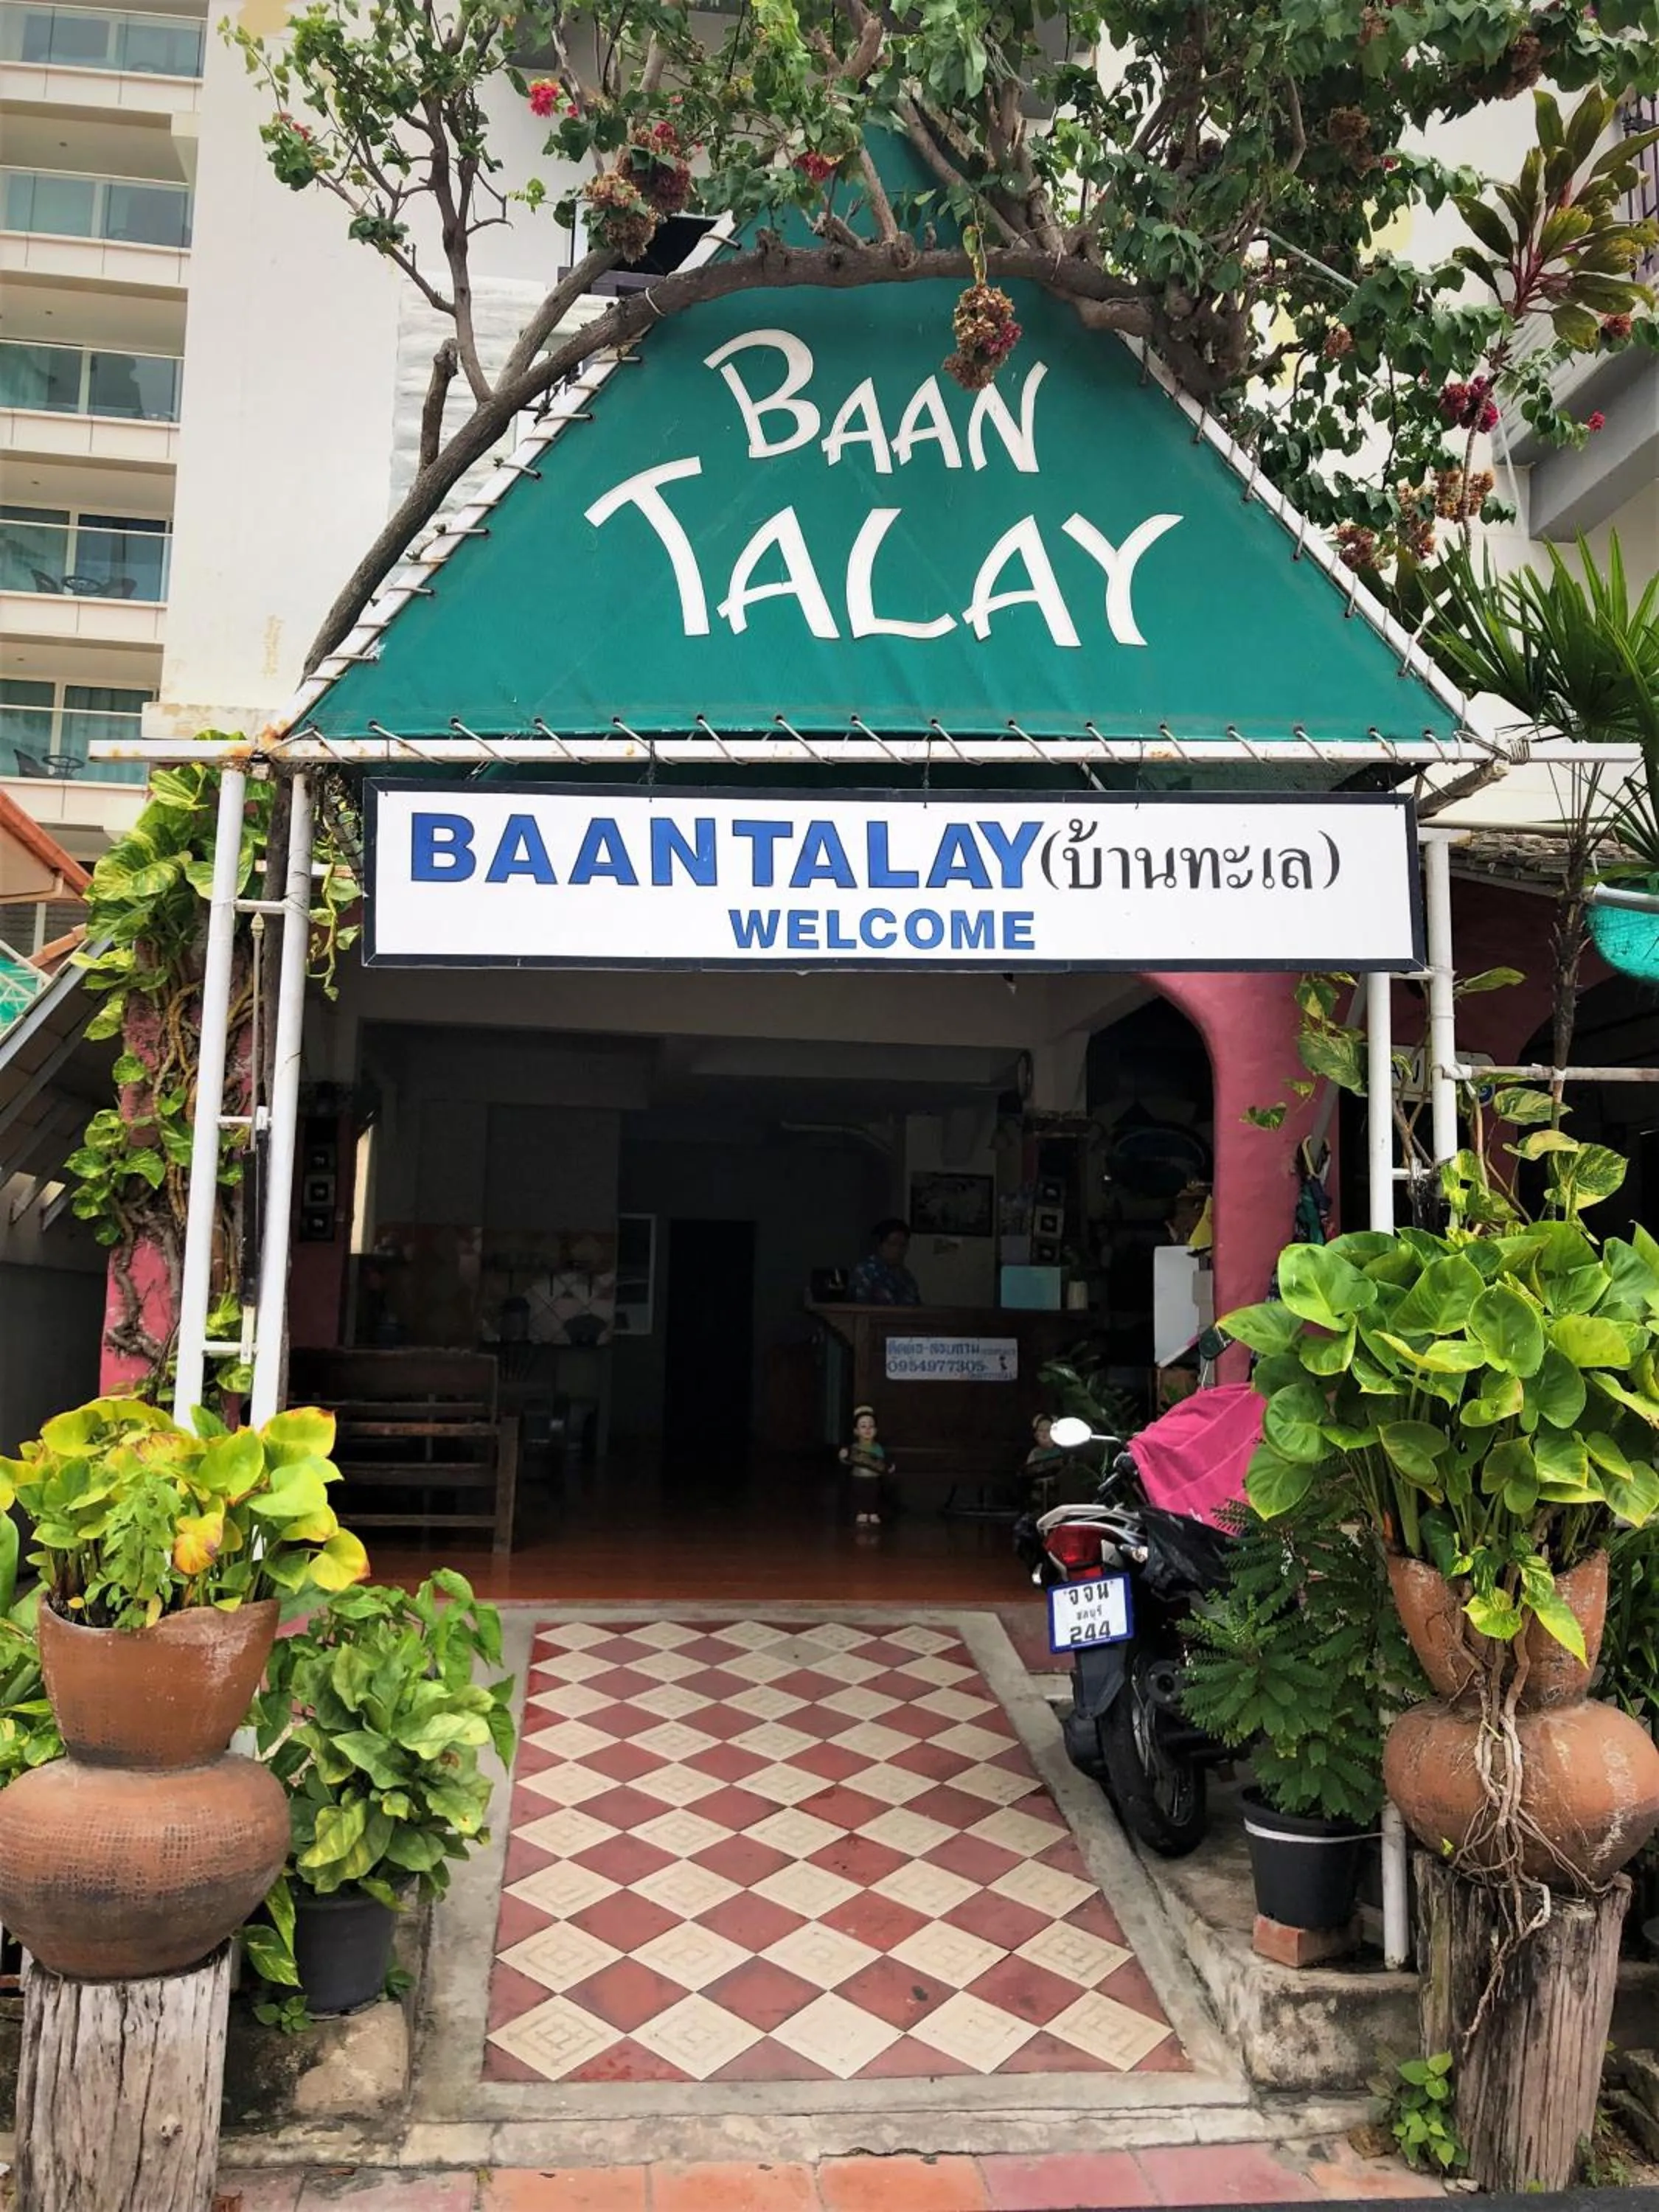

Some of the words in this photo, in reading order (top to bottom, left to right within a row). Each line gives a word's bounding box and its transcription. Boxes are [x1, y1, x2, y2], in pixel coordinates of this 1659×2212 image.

[703, 329, 1048, 474] BAAN
[583, 456, 1184, 647] TALAY
[728, 908, 1035, 950] WELCOME
[1070, 1620, 1111, 1644] 244
